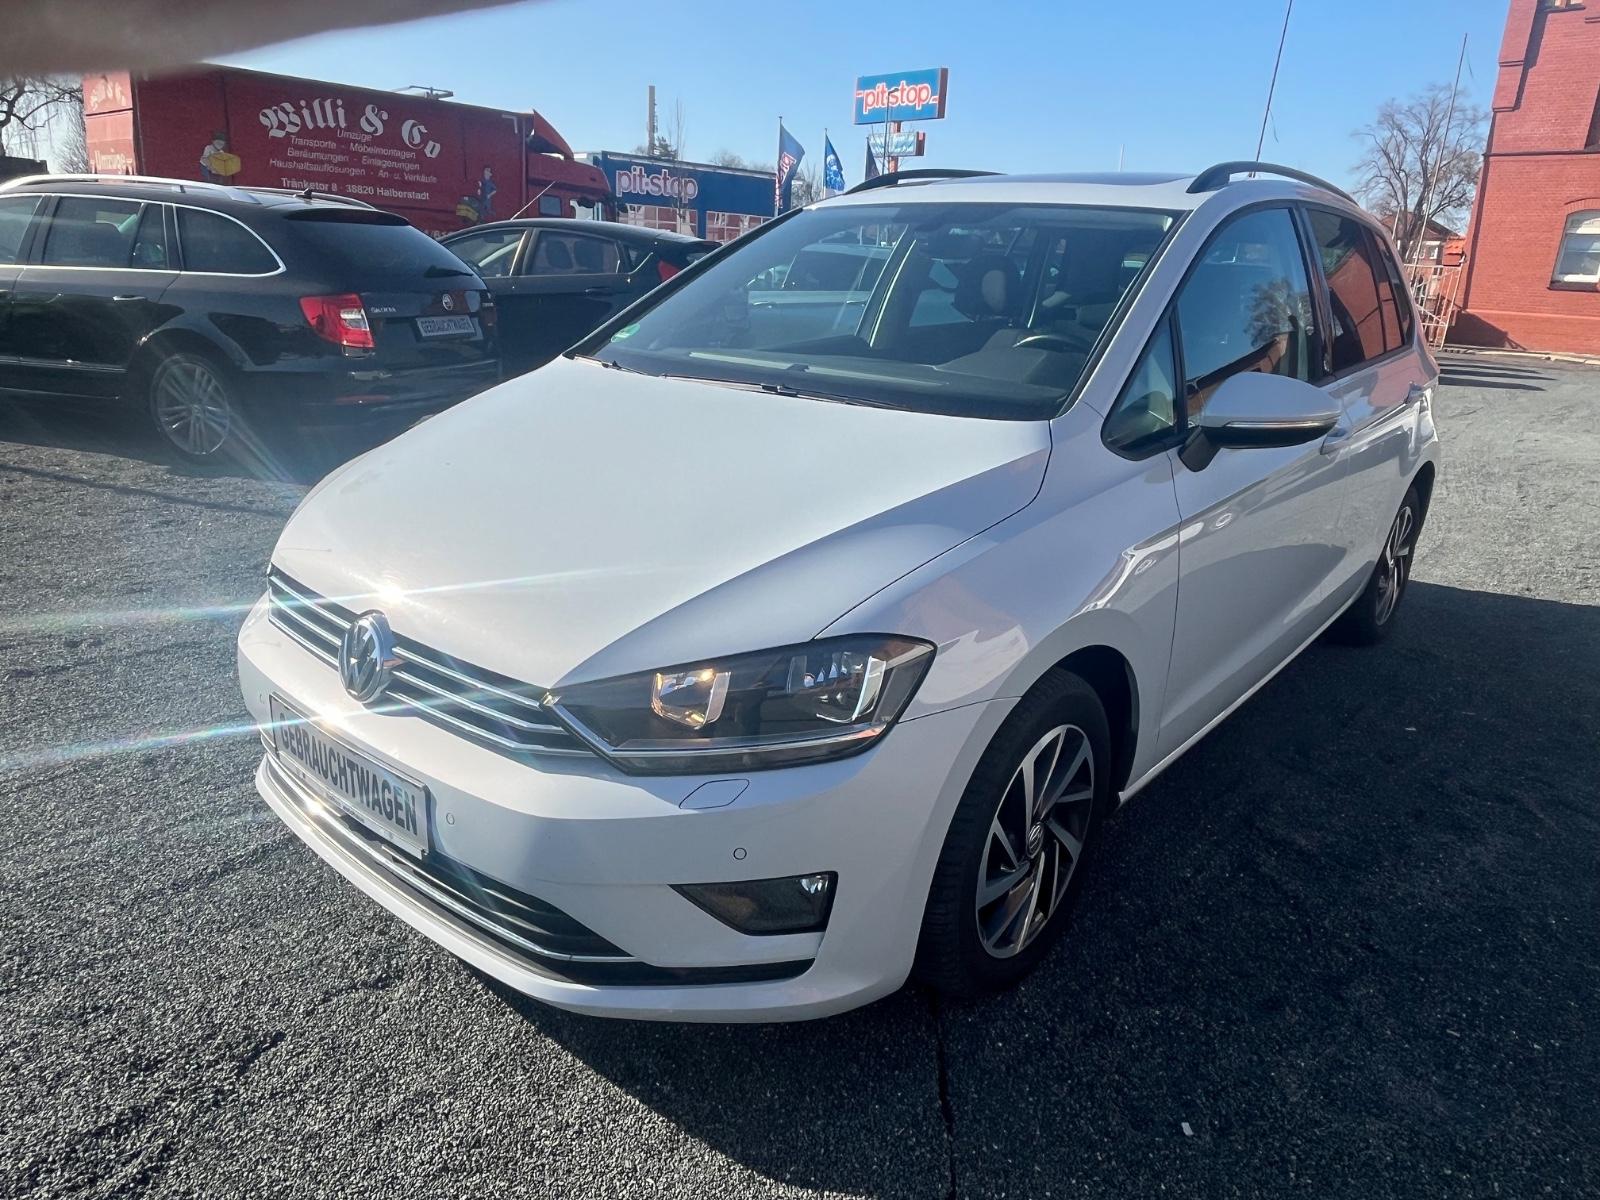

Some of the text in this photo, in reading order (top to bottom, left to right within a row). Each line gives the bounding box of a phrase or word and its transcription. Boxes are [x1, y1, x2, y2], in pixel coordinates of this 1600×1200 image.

[259, 98, 441, 158] Willi & Co
[376, 187, 430, 200] Halberstadt
[279, 711, 418, 836] GEBRAUCHTWAGEN
